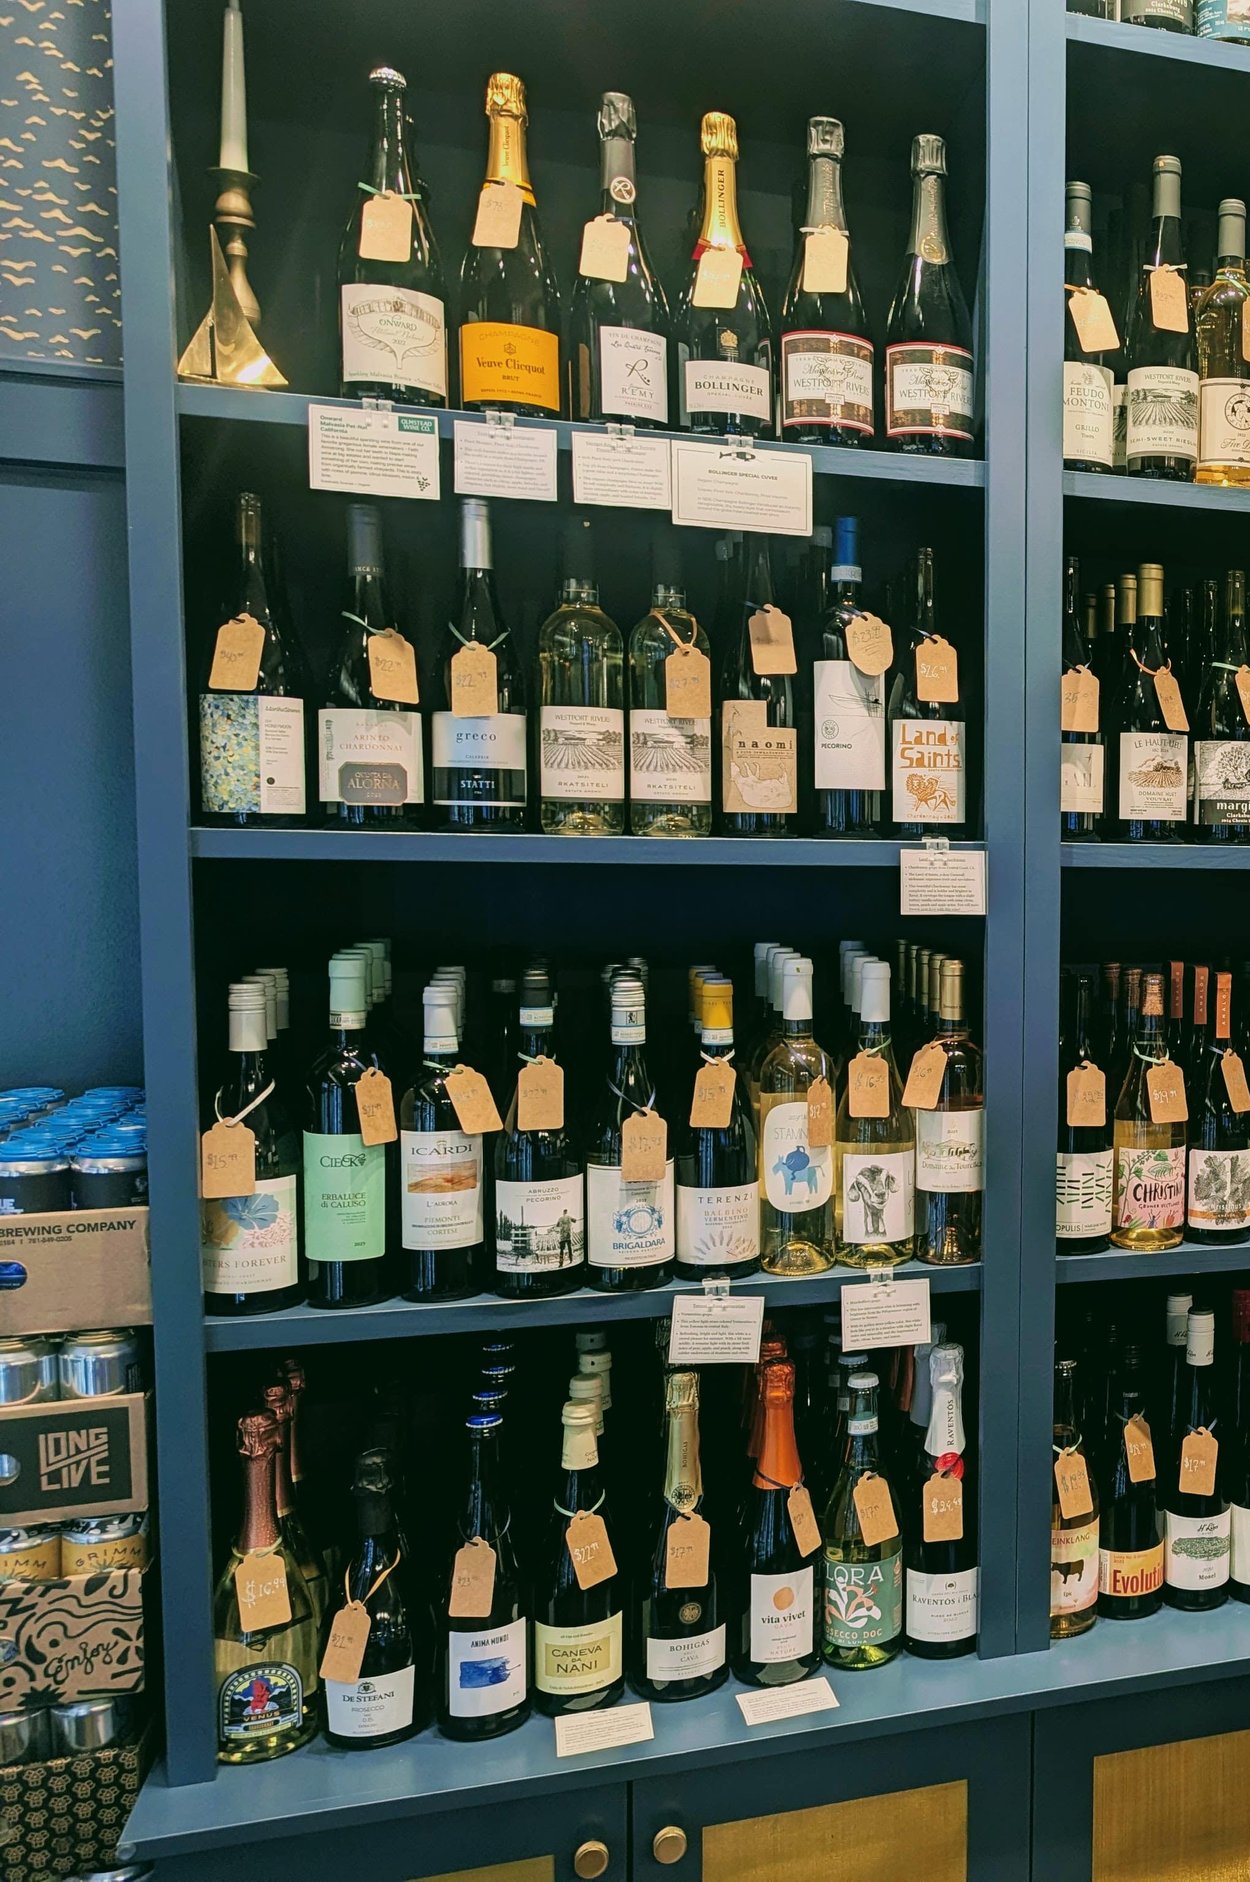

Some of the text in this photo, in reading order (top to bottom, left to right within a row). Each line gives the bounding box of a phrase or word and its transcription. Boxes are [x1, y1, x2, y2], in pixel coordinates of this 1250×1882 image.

[379, 318, 417, 332] ONWARD
[476, 357, 545, 375] Veuve Clicquot
[694, 380, 764, 397] BOLLINGER
[1070, 386, 1105, 400] FEUDO
[401, 418, 432, 427] OLMSTEAD
[456, 732, 497, 742] greco
[900, 724, 948, 746] Land
[900, 747, 961, 768] Saints
[348, 779, 400, 790] ALORNA
[460, 780, 495, 789] STATTI
[411, 1144, 473, 1156] ICARDI
[321, 1192, 367, 1201] ERBALUCE
[698, 1193, 753, 1204] TERENZI
[331, 1200, 367, 1209] CALUSO
[66, 1220, 136, 1234] COMPANY
[612, 1238, 666, 1251] BRIGALDARA
[39, 1427, 108, 1467] LONG
[41, 1453, 110, 1491] LIVE
[761, 1610, 806, 1624] vita vivet
[863, 1628, 882, 1638] DOC
[470, 1638, 490, 1649] ANIMA
[669, 1639, 710, 1652] BOHIGAS
[551, 1645, 602, 1657] CANEVA
[557, 1660, 598, 1673] NANI
[357, 1691, 395, 1702] STEFANI
[243, 1711, 280, 1722] VENUS
